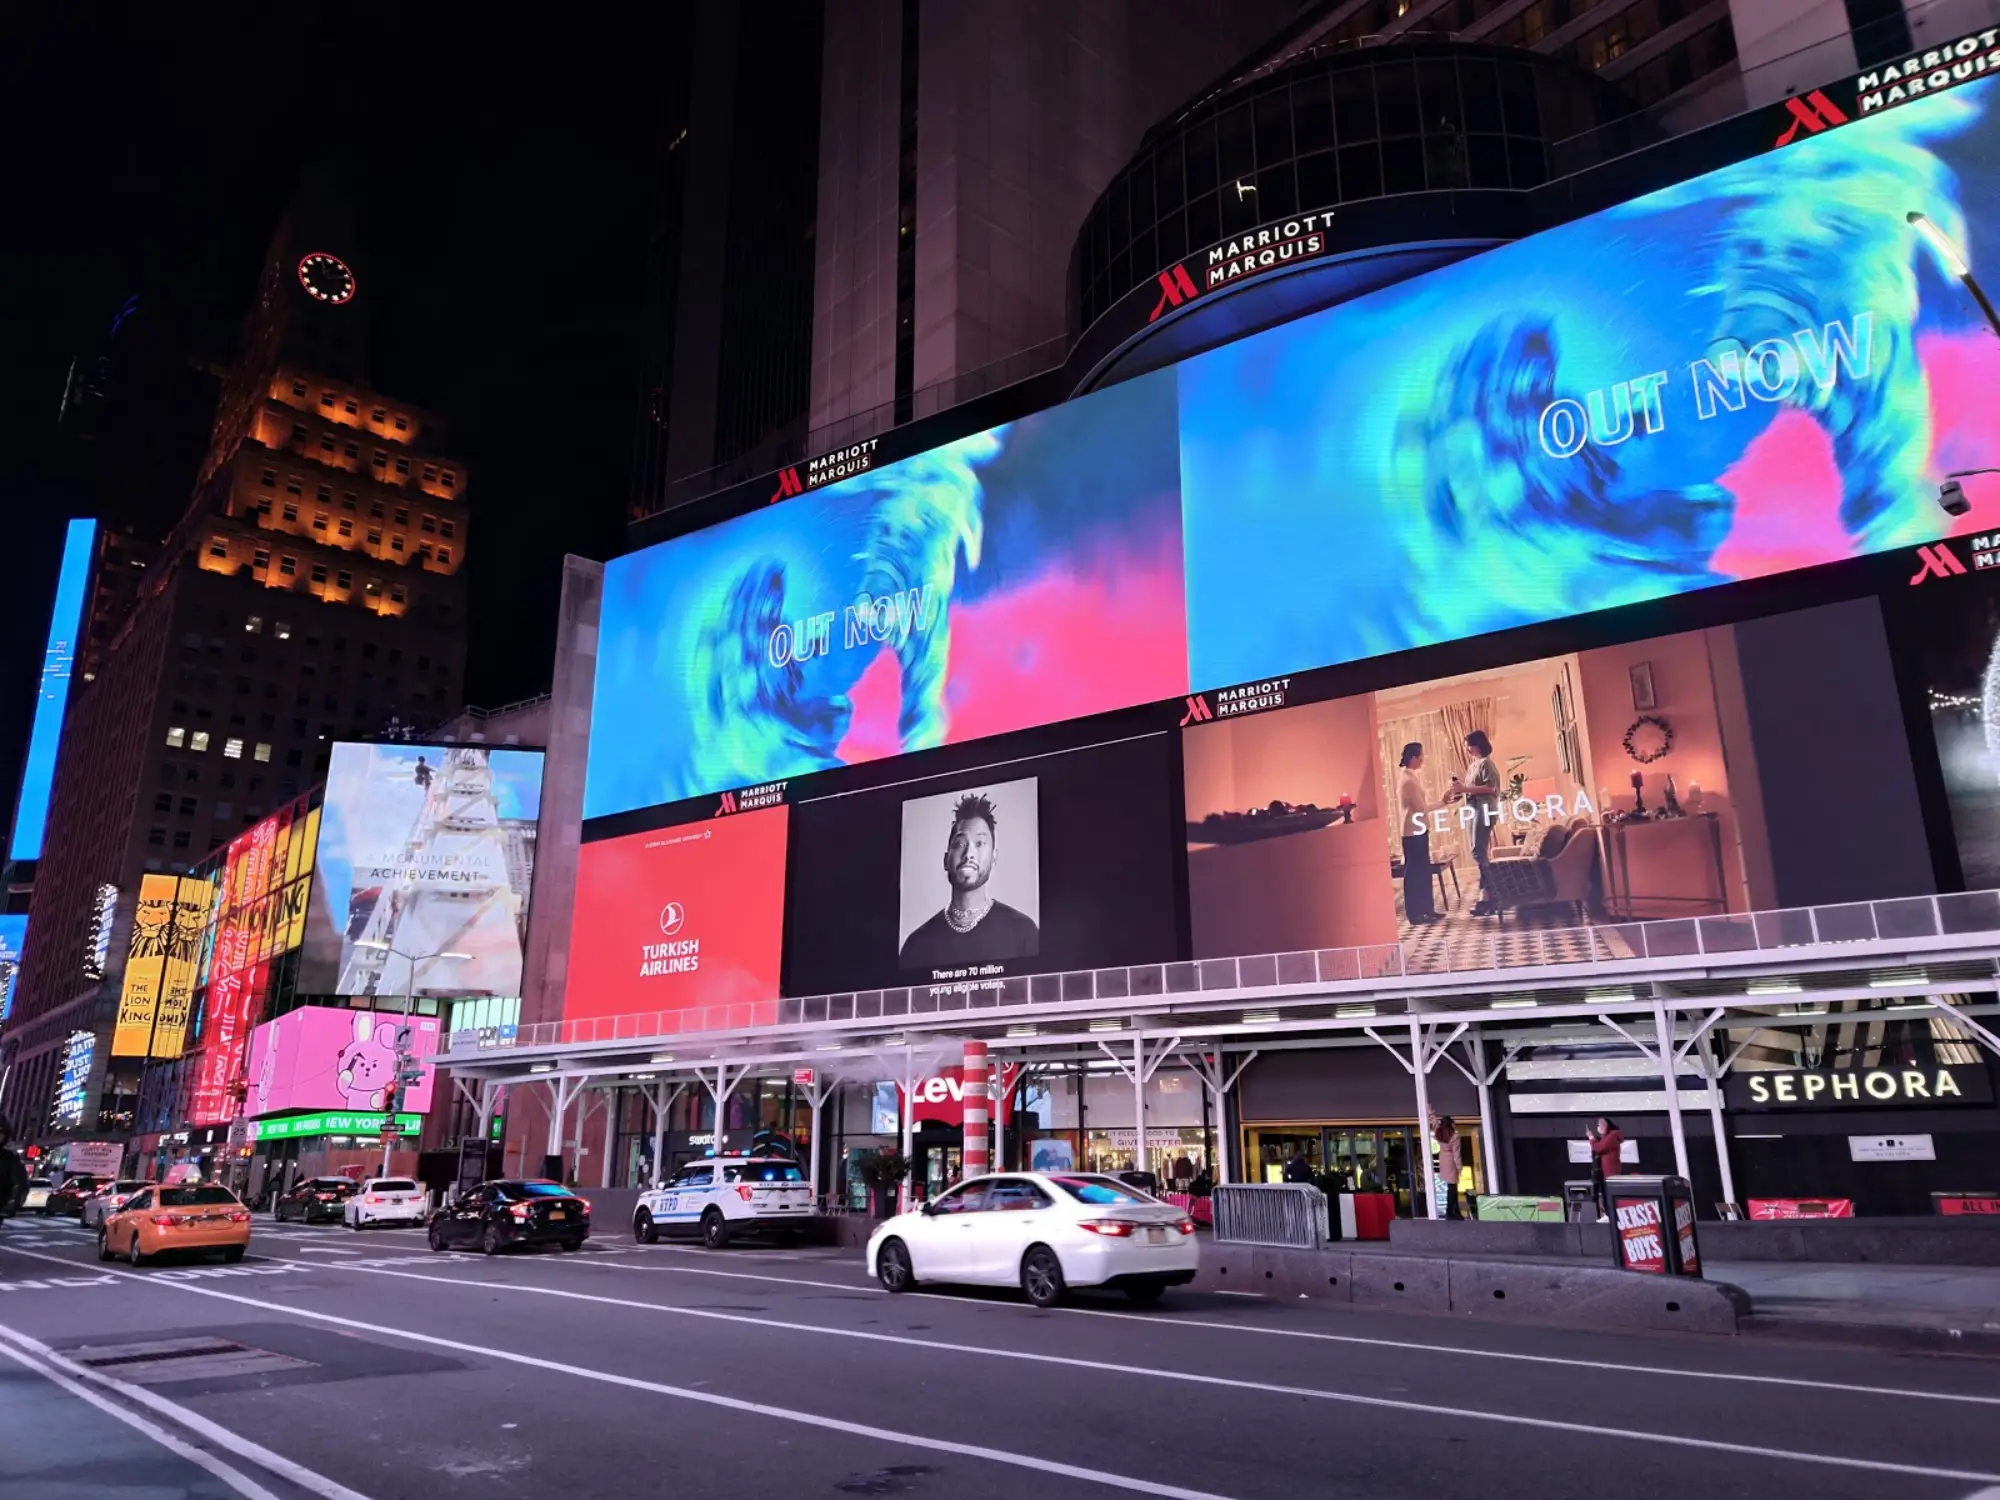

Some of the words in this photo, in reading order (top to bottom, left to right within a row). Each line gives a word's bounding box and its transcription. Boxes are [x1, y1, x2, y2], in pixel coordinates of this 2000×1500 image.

[1858, 28, 2000, 92] MARRIOT
[1209, 212, 1335, 265] MARRIOTT
[1210, 237, 1320, 285] MARQUIS
[1539, 370, 1668, 459] OUT
[1691, 311, 1874, 420] NOW
[809, 439, 878, 472] MARRIOTT
[809, 457, 868, 485] MARQUIS
[768, 611, 835, 668] OUT
[844, 583, 933, 650] NOW
[1218, 679, 1290, 702] MARRIOTT
[1219, 695, 1282, 715] MARQUIS
[741, 782, 788, 798] MARRIOTT
[741, 793, 781, 809] MARQUIS
[1411, 789, 1594, 836] SEPHORA
[383, 853, 491, 867] MONUMENTAL
[370, 868, 480, 882] ACHIEVEMENT
[642, 938, 700, 960] TURKISH
[640, 955, 699, 977] AIRLINES
[932, 970, 953, 979] There
[954, 969, 967, 977] are
[968, 966, 978, 976] 70
[979, 964, 1004, 975] million
[131, 984, 148, 992] THE
[125, 993, 150, 1006] LION
[120, 1008, 151, 1023] KING
[1749, 1069, 1962, 1102] SEPHORA
[233, 1128, 246, 1136] 25
[689, 1134, 716, 1145] swatc
[660, 1196, 678, 1212] NYPD
[1962, 1200, 1985, 1212] ALL
[1616, 1200, 1662, 1231] JERSEY
[1623, 1234, 1663, 1263] BOYS
[149, 1263, 314, 1281] ONLY
[0, 1274, 122, 1291] NLY
